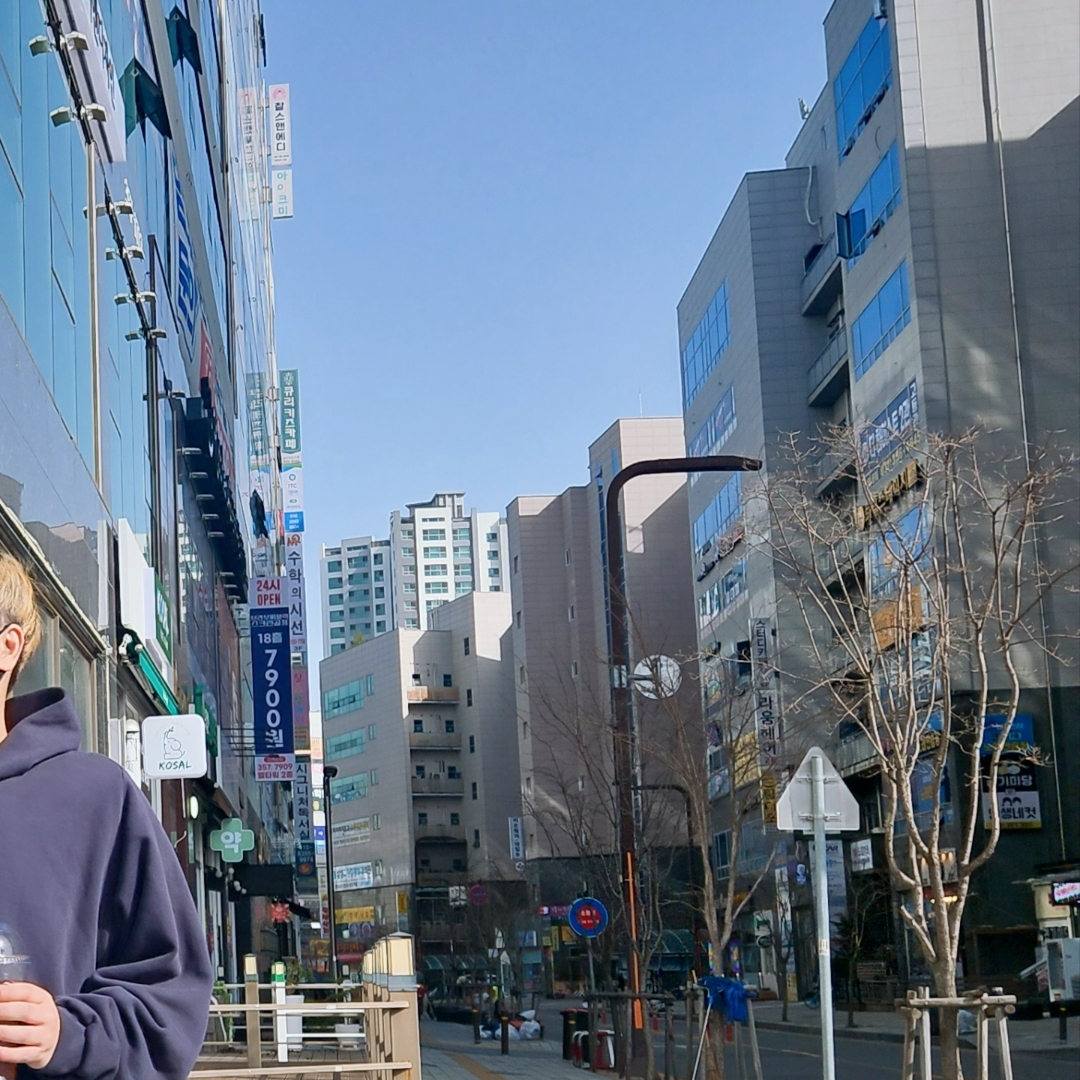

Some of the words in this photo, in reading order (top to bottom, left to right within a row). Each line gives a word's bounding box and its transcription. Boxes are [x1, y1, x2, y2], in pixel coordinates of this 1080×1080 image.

[256, 580, 281, 592] 24시
[257, 593, 281, 606] OPEN
[258, 632, 283, 645] 18홀
[158, 761, 192, 770] KOSAL
[220, 831, 242, 853] 약
